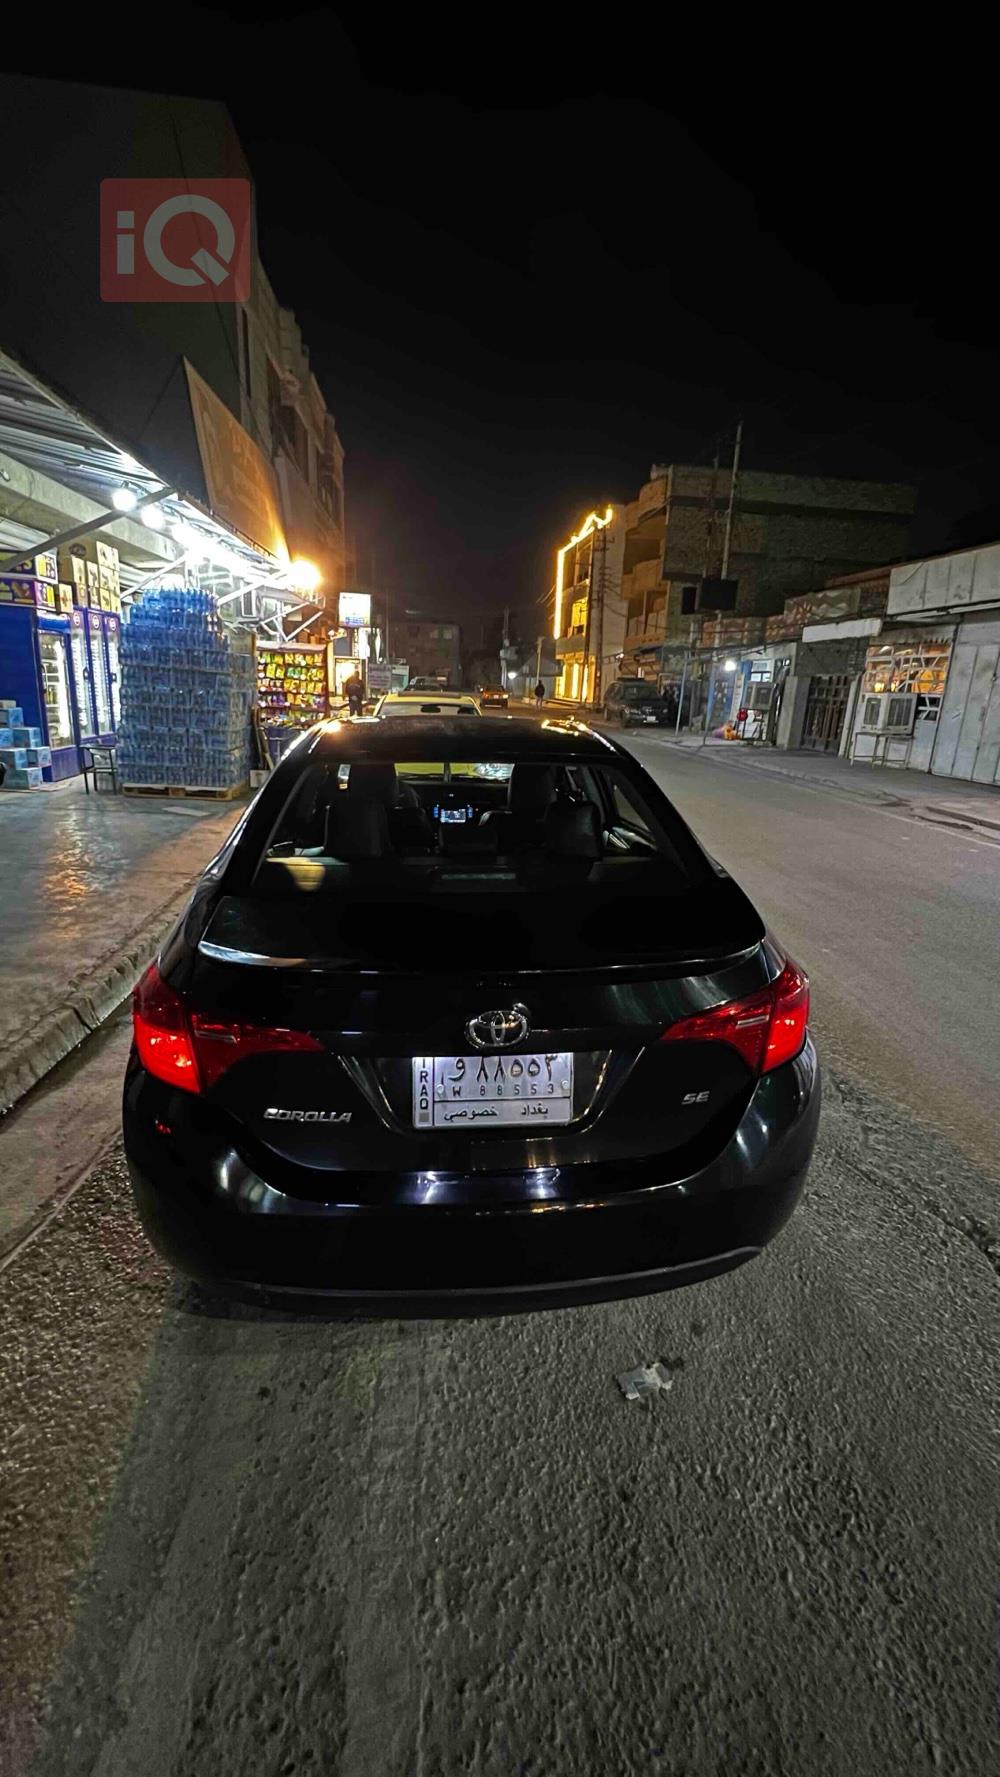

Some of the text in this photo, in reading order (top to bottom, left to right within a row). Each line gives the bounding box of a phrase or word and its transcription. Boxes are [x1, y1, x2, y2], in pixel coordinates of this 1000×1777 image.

[419, 1057, 429, 1110] IRAQ
[452, 1086, 462, 1097] W
[681, 1090, 710, 1105] SE
[263, 1107, 353, 1123] COROLLA
[444, 1103, 549, 1122] بغداد خصوصي
